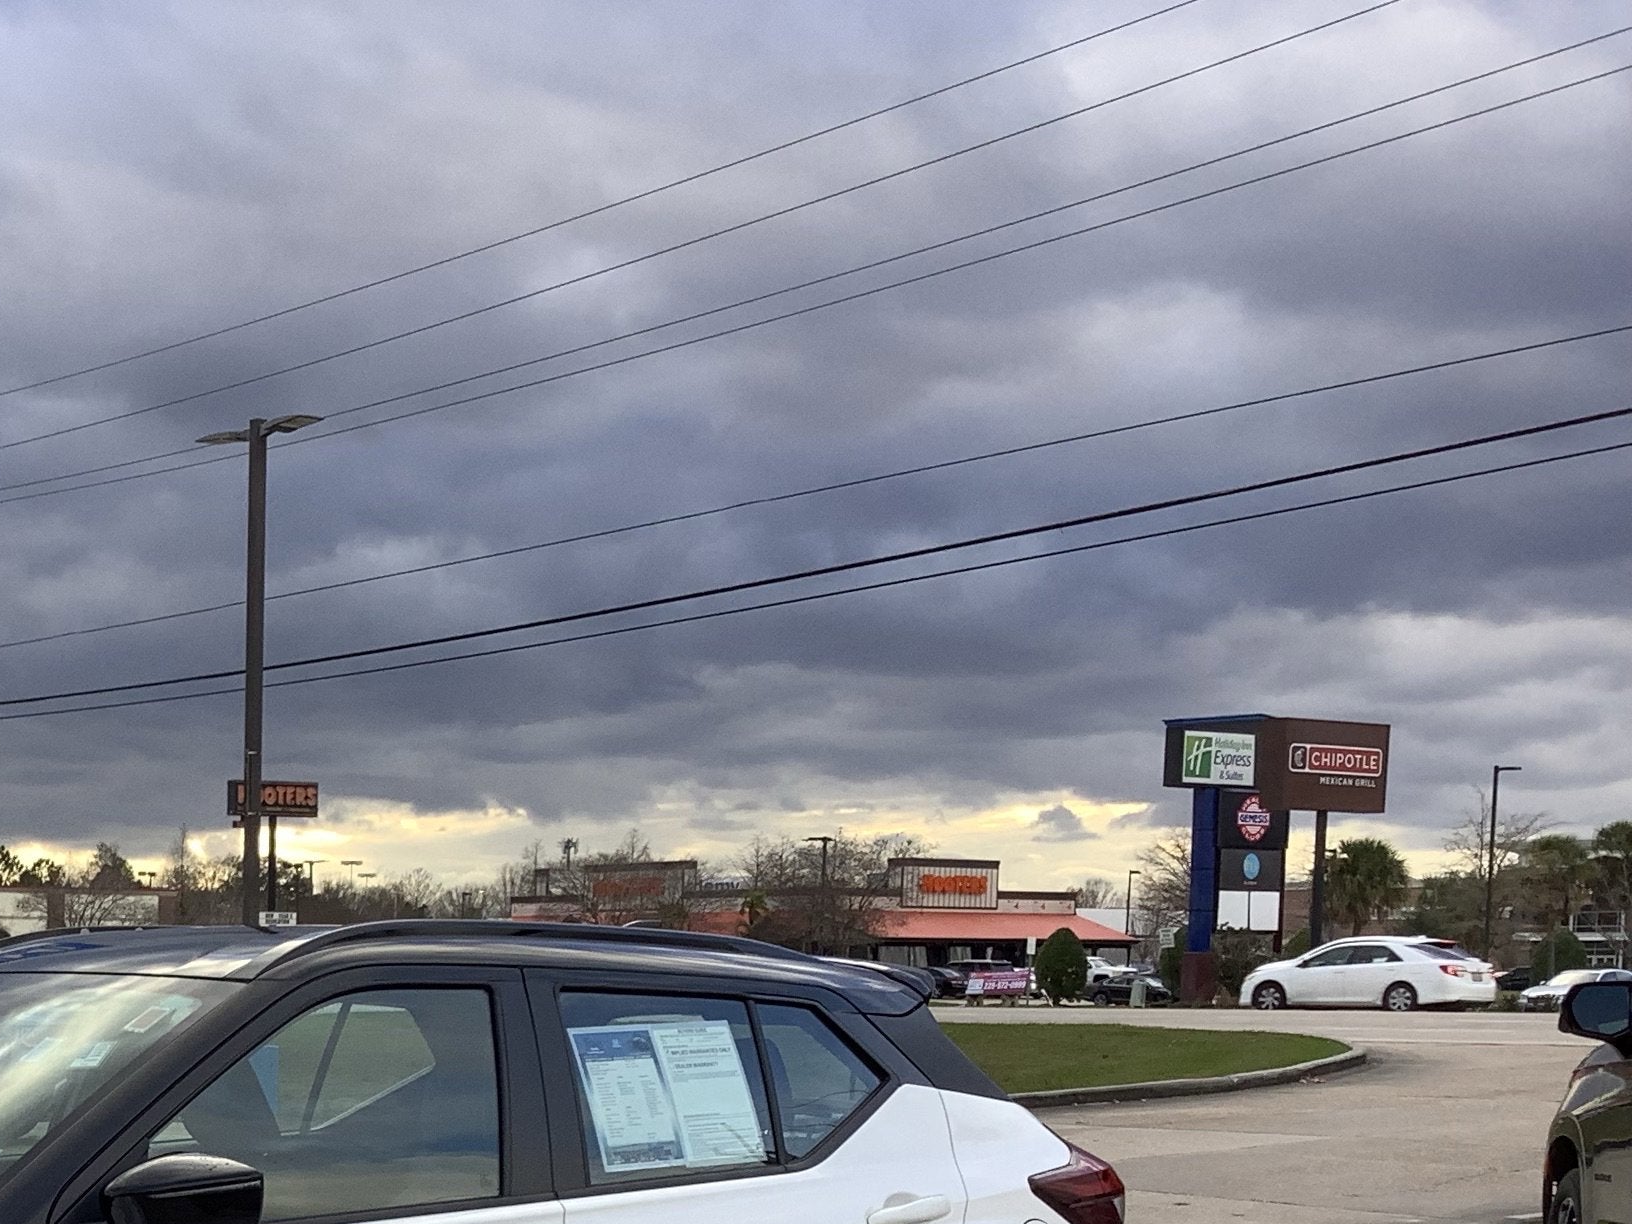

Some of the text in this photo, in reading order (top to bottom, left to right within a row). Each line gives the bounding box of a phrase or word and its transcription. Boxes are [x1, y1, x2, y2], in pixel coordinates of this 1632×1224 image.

[1214, 750, 1252, 769] Express
[1311, 751, 1378, 770] CHIPOTLE
[1319, 776, 1376, 788] MEXICAN GRILL
[237, 783, 317, 806] OTERS
